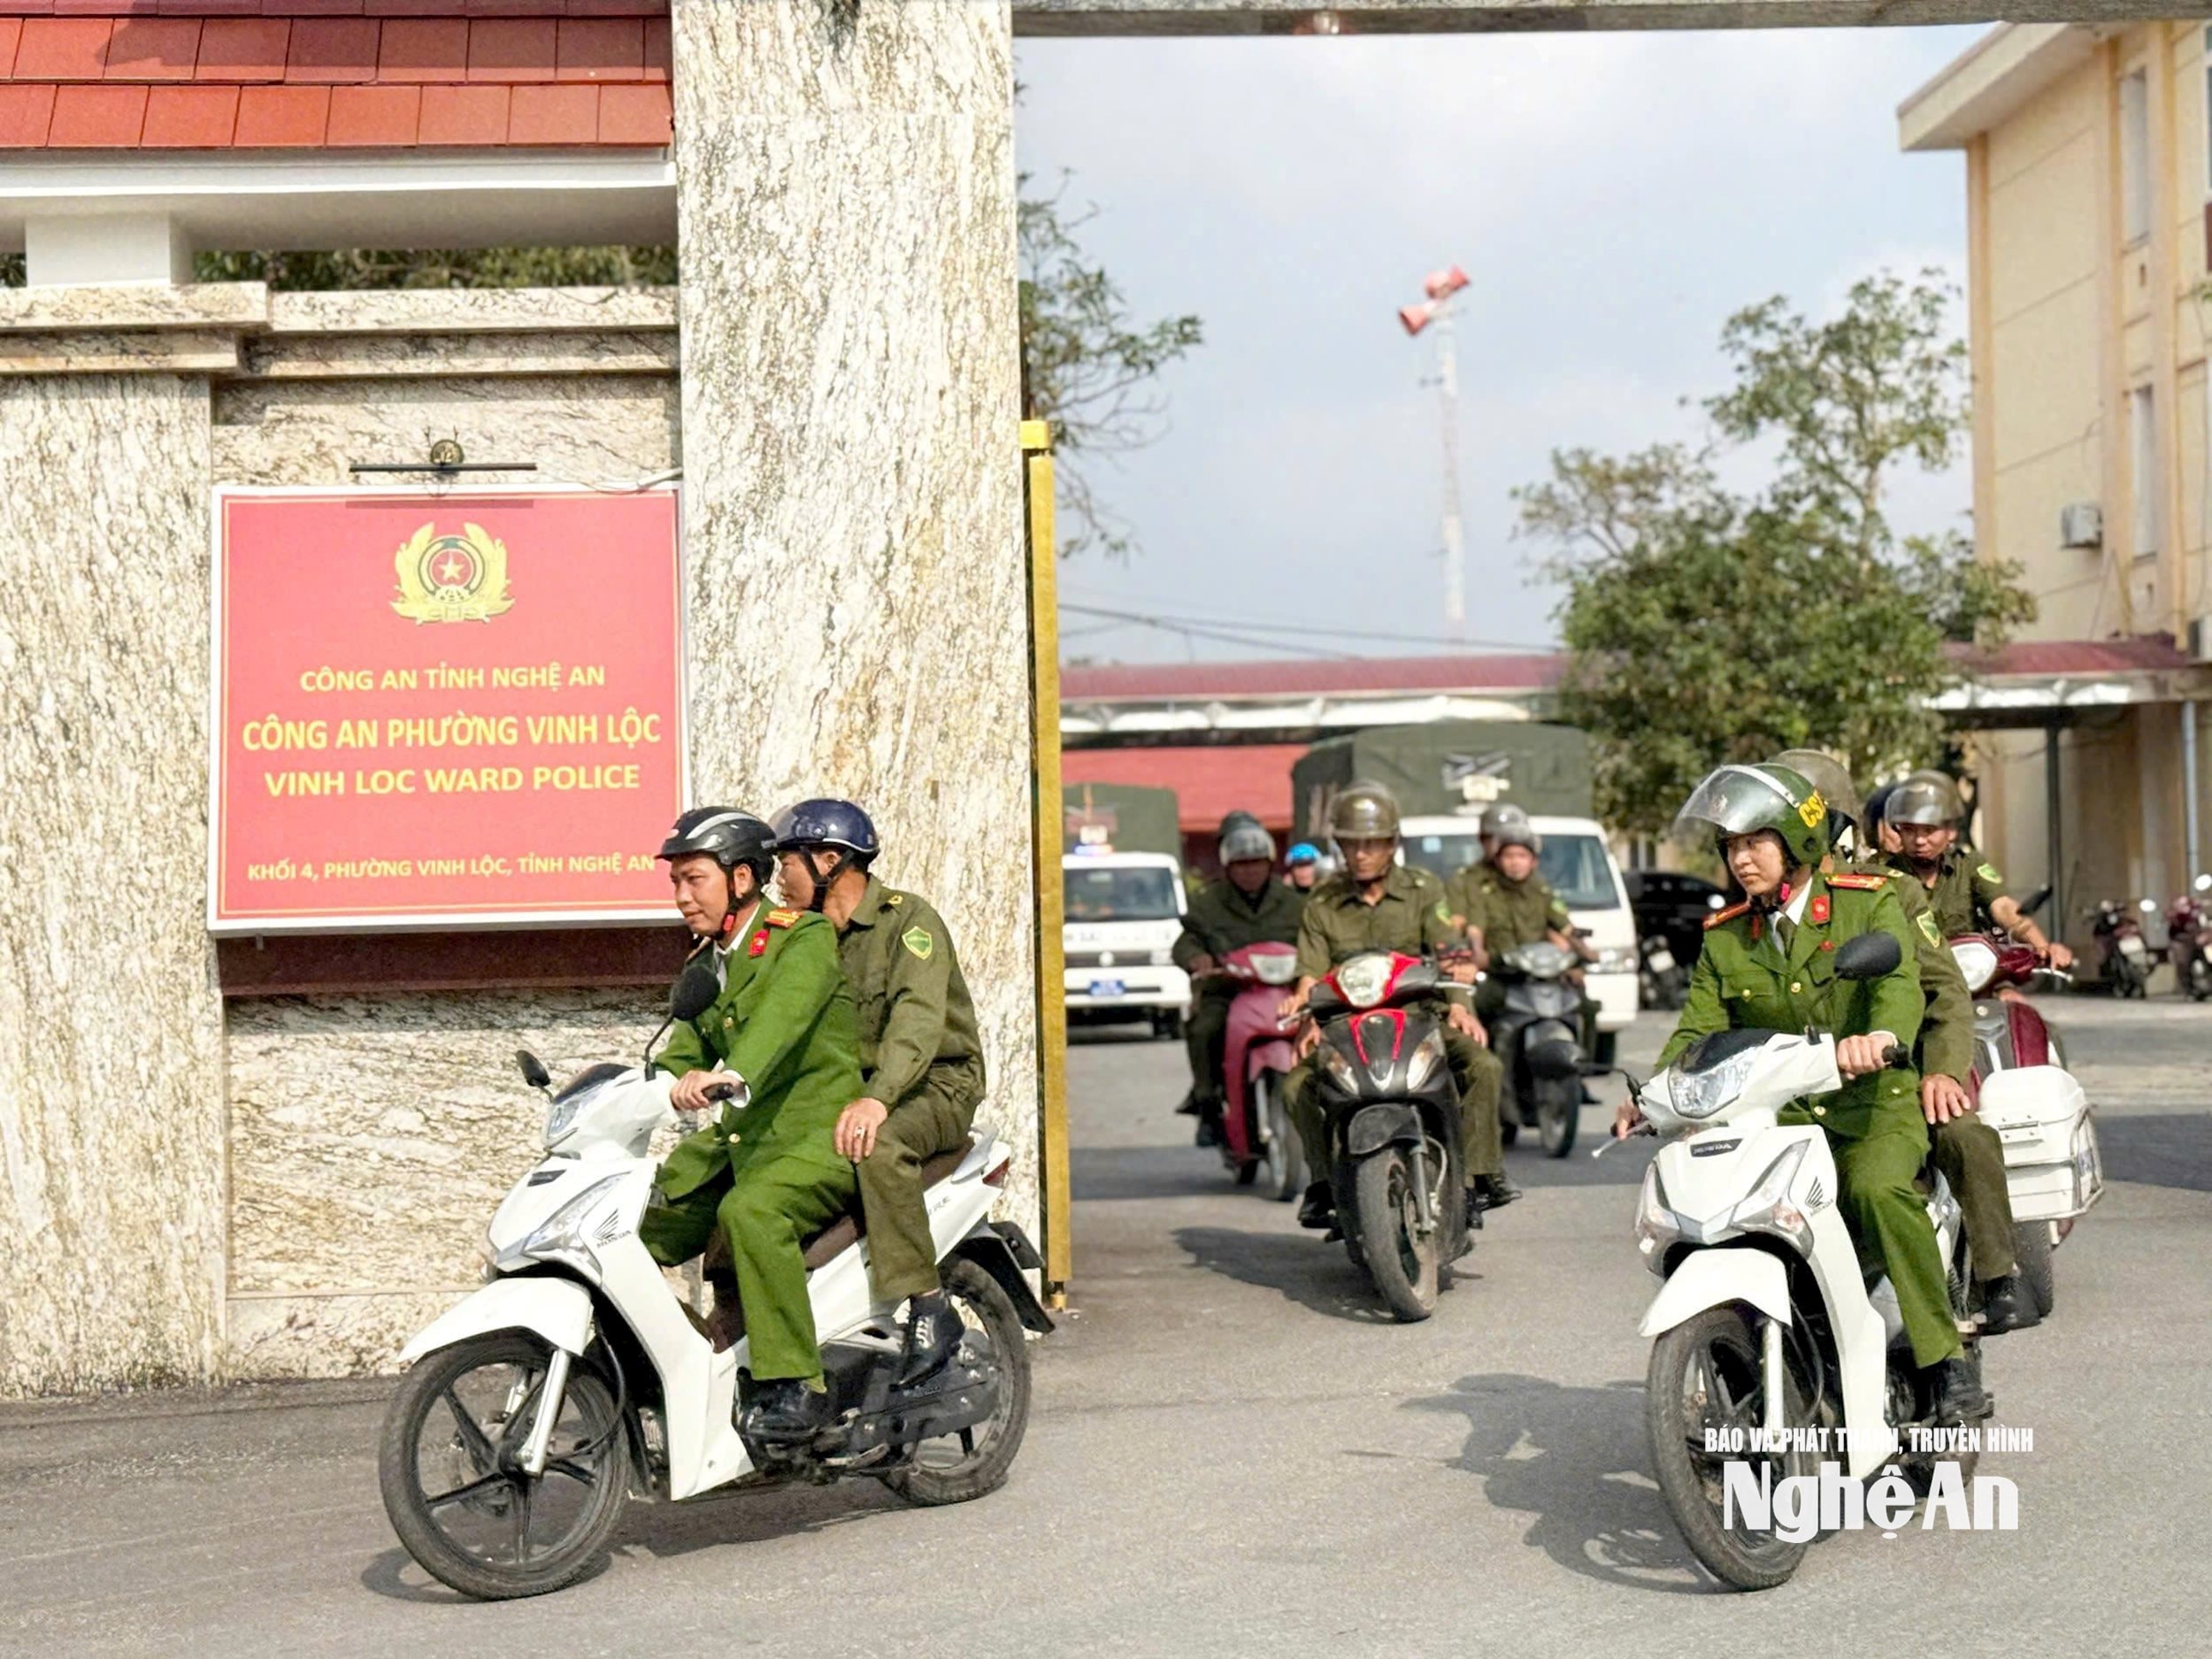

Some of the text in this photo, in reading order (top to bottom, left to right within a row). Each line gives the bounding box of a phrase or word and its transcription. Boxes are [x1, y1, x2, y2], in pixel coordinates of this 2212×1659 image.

[300, 661, 605, 692] CÔNG AN TỈNH NGHỆ AN
[242, 706, 661, 750] CÔNG AN PHƯỜNG VINH LỘC
[265, 764, 641, 796] VINH LOC WARD POLICE
[1799, 788, 1826, 827] CS
[248, 852, 656, 882] KHỐI 4, PHƯỜNG VINH LỘC, TỈNH NGHỆ AN
